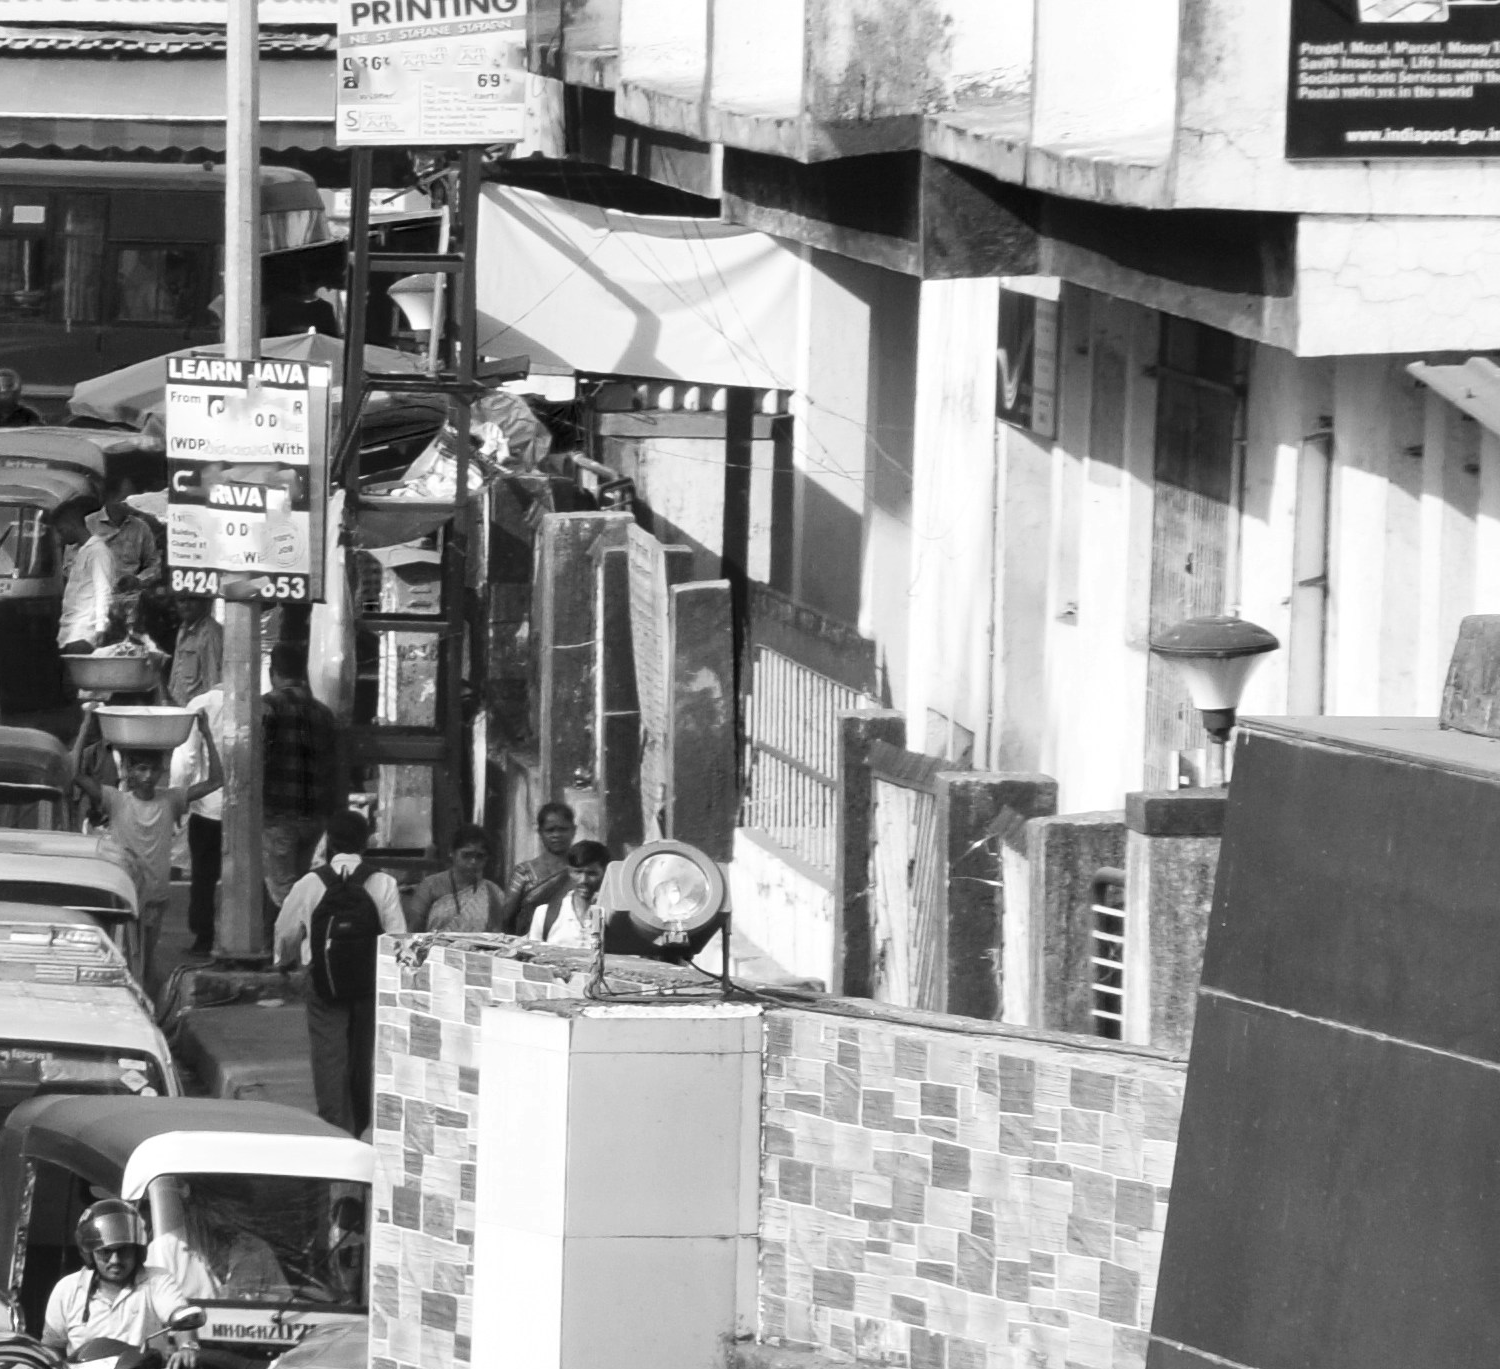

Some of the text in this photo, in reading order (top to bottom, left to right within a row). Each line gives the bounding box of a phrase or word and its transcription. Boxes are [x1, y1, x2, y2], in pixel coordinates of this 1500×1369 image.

[352, 0, 517, 27] PRINTING
[168, 358, 242, 382] LEARN
[170, 391, 202, 404] From
[272, 442, 305, 455] With
[171, 570, 218, 594] 8424
